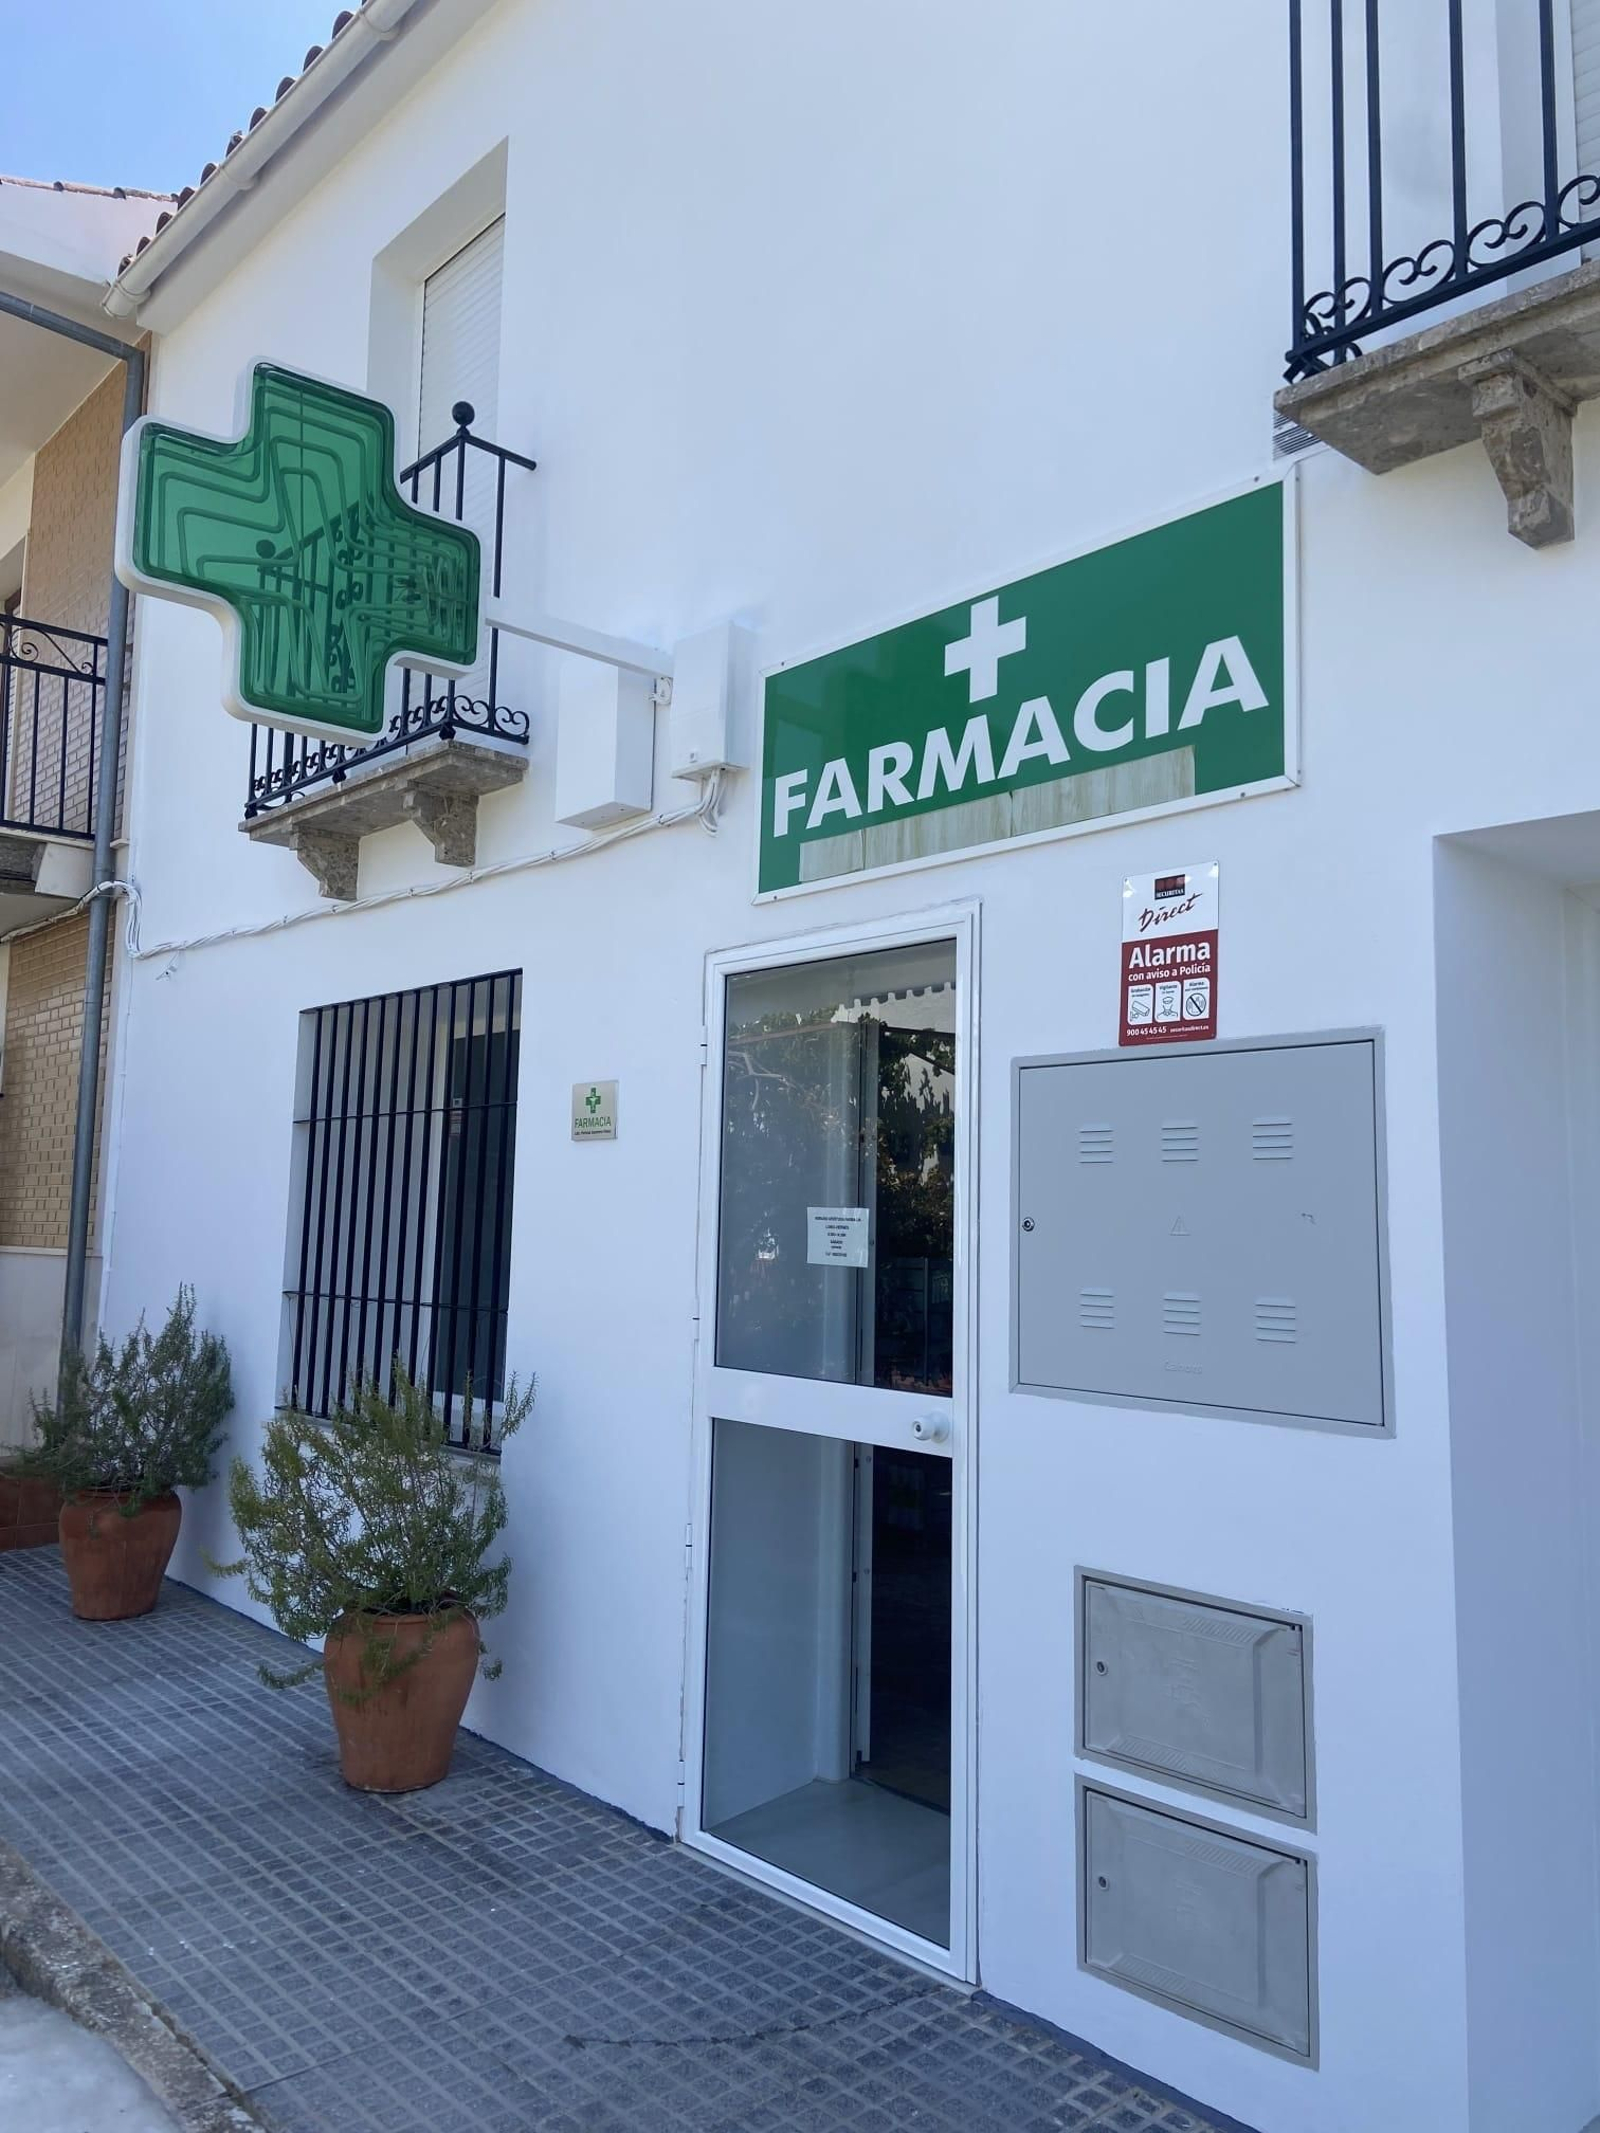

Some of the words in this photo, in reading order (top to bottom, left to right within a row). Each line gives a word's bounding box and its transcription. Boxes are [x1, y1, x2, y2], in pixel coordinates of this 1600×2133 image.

[773, 635, 1269, 838] FARMACIA
[1156, 889, 1184, 898] SECURITAS
[1138, 892, 1203, 932] Direct
[1128, 941, 1210, 969] Alarma
[1128, 970, 1145, 982] con
[1146, 965, 1170, 980] aviso
[1171, 966, 1178, 977] a
[1179, 962, 1211, 976] Policía
[1126, 1029, 1140, 1037] 900
[1140, 1028, 1149, 1036] 45
[1149, 1027, 1158, 1035] 45
[1158, 1026, 1167, 1034] 45
[574, 1116, 612, 1128] FARMACIA
